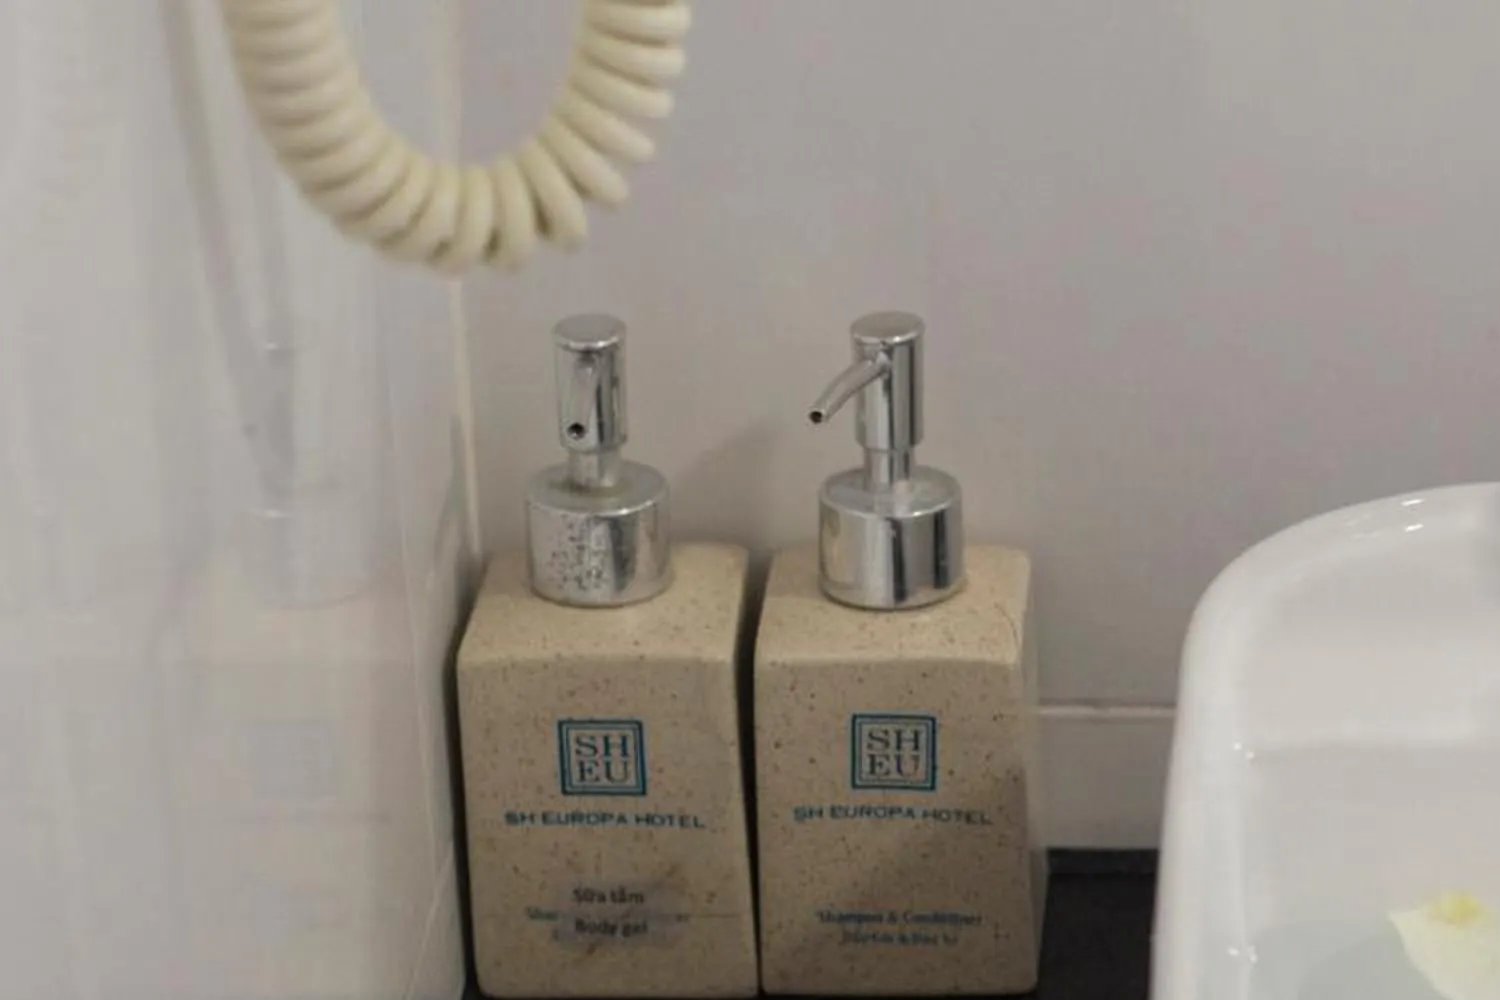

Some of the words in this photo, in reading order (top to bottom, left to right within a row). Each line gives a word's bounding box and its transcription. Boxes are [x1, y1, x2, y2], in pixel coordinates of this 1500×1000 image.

[574, 734, 631, 758] SH
[866, 728, 922, 752] SH
[577, 760, 631, 783] EU
[867, 753, 921, 777] EU
[504, 811, 536, 826] SH
[541, 811, 627, 827] EUROPA
[635, 813, 706, 829] HOTEL
[793, 806, 824, 822] SH
[829, 804, 916, 821] EUROPA
[921, 807, 994, 826] HOTEL
